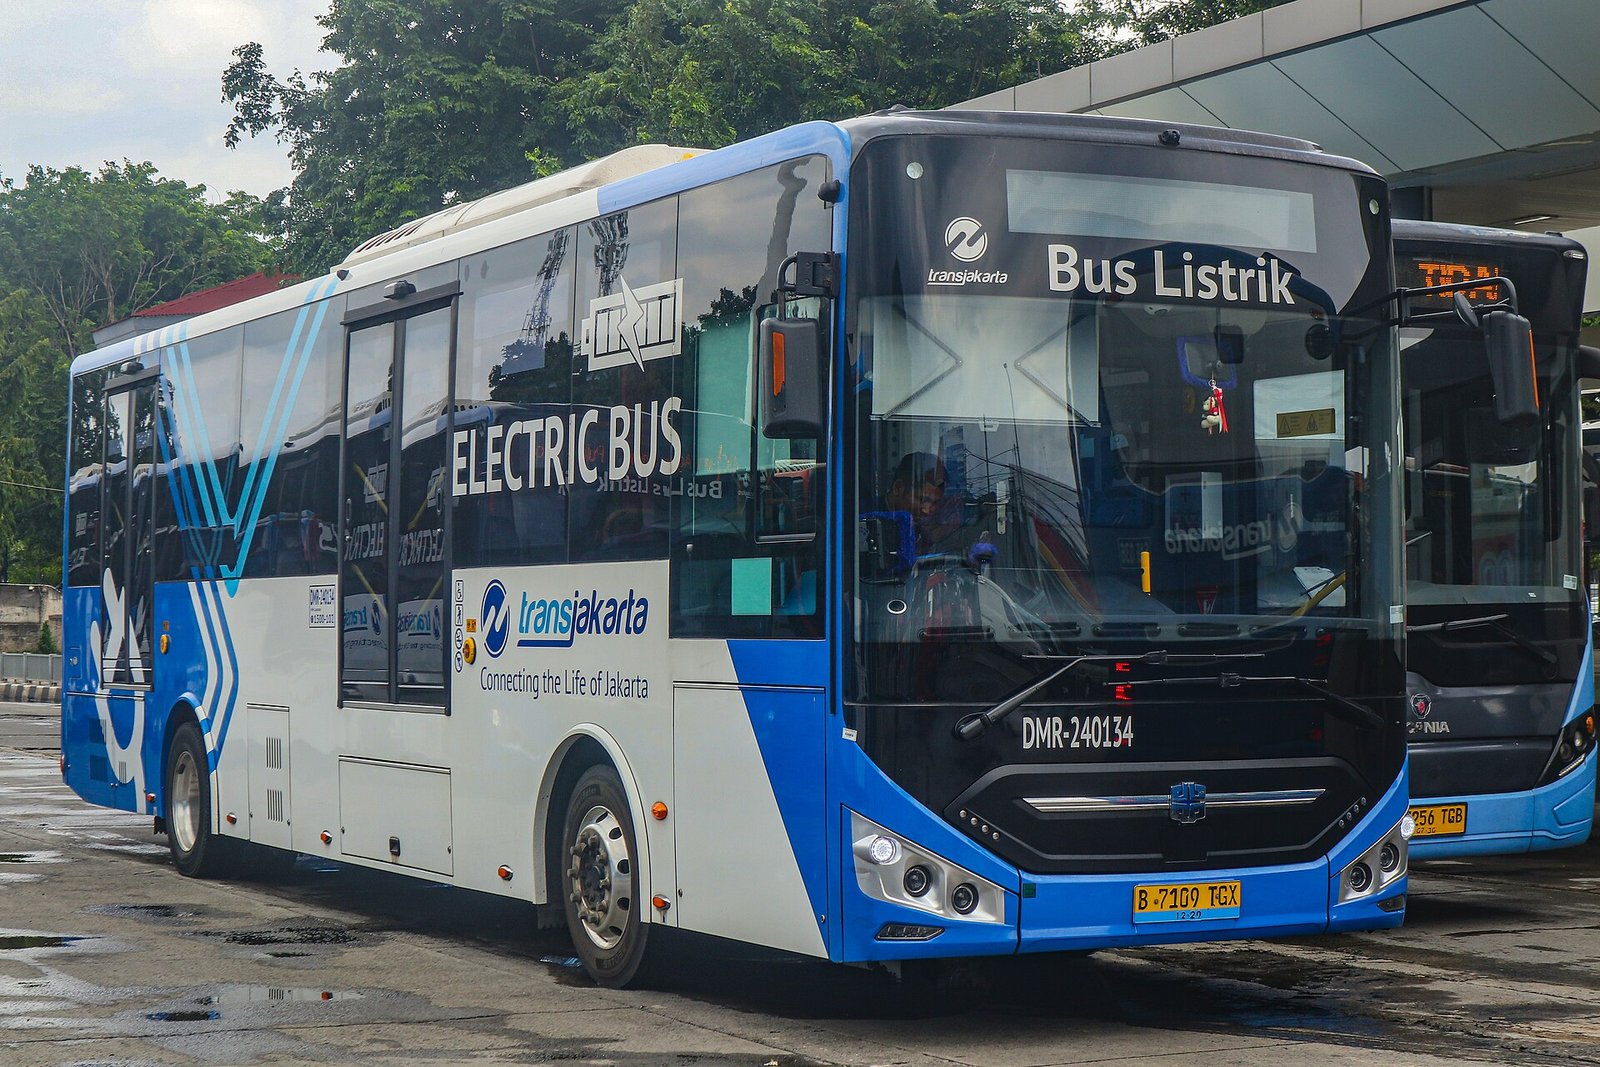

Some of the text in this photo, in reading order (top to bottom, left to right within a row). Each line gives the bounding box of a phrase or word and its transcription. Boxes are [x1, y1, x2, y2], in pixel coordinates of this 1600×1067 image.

[927, 269, 1008, 286] transjakarta
[1047, 243, 1295, 305] Bus Listrik
[452, 408, 600, 497] ELECTRIC
[608, 396, 682, 481] BUS
[517, 588, 649, 648] transjakarta
[480, 667, 649, 700] Connecting the Life of Jakarta
[1022, 715, 1134, 749] DMR-240134
[1409, 807, 1463, 826] 256 TGB
[1138, 884, 1237, 910] B 7109 TGX
